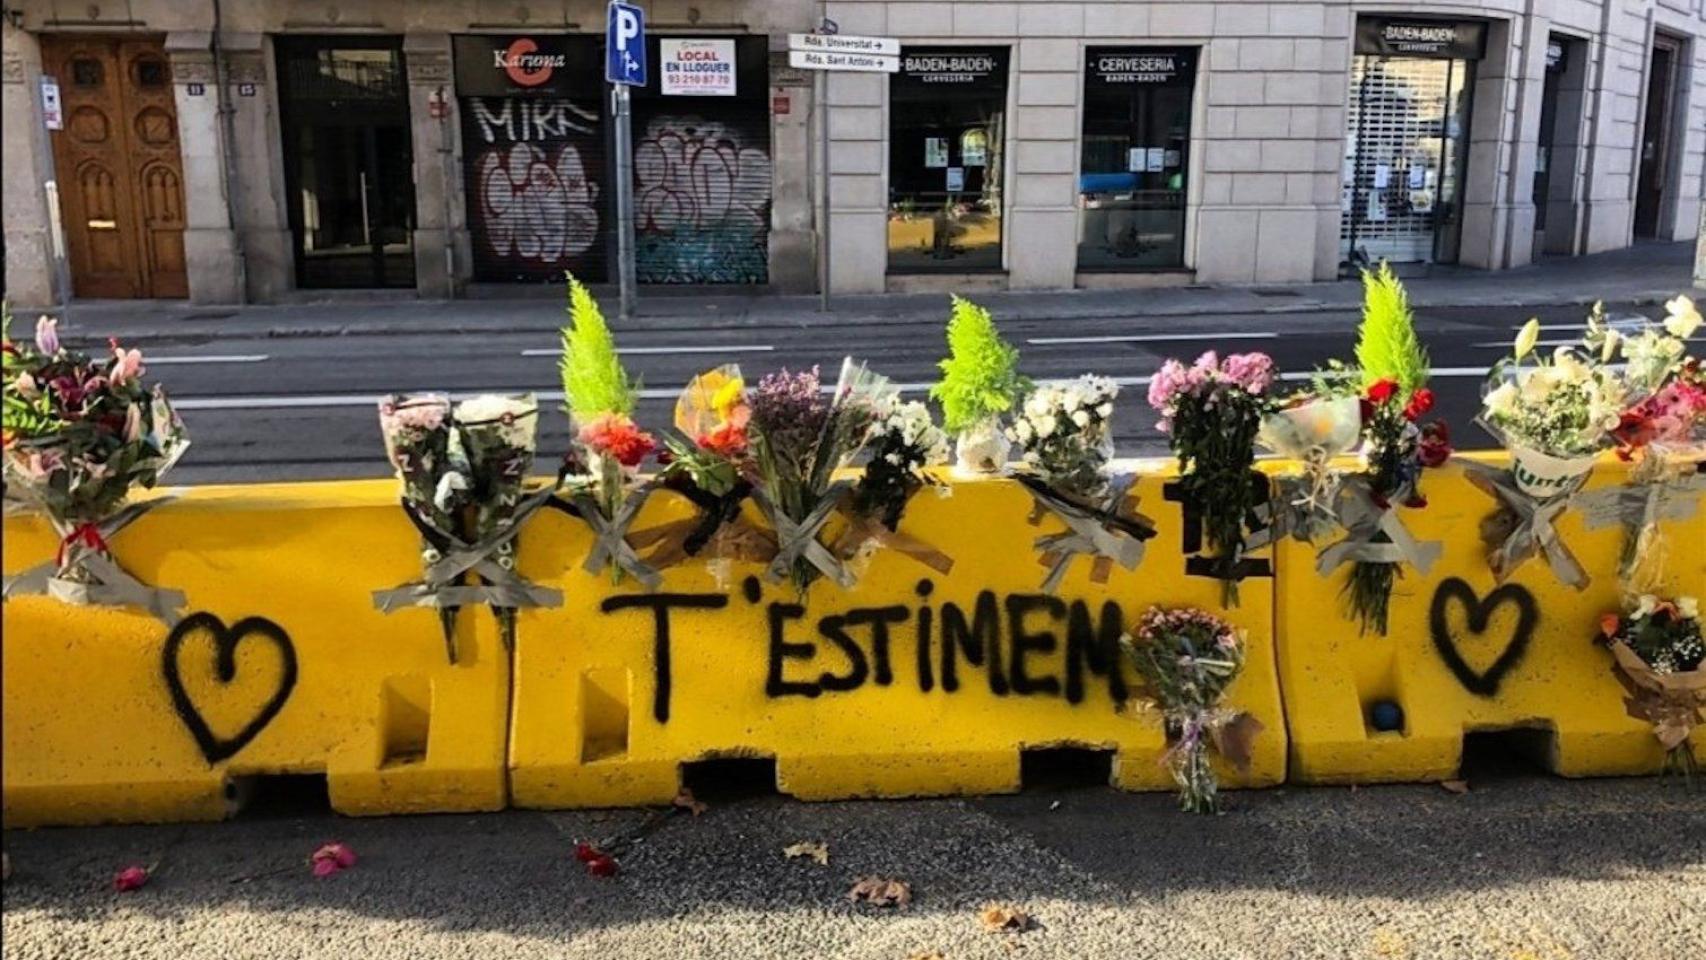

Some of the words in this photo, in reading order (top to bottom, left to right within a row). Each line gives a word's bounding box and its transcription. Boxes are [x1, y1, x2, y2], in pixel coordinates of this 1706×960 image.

[617, 8, 638, 51] P
[826, 38, 873, 49] Universitat
[677, 50, 719, 62] LOCAL
[827, 56, 846, 65] Sant
[848, 57, 874, 67] Antoni
[665, 62, 680, 73] EN
[683, 63, 730, 74] LLOGUER
[905, 58, 992, 72] BADEN-BADEN
[1098, 58, 1175, 72] CERVESERIA
